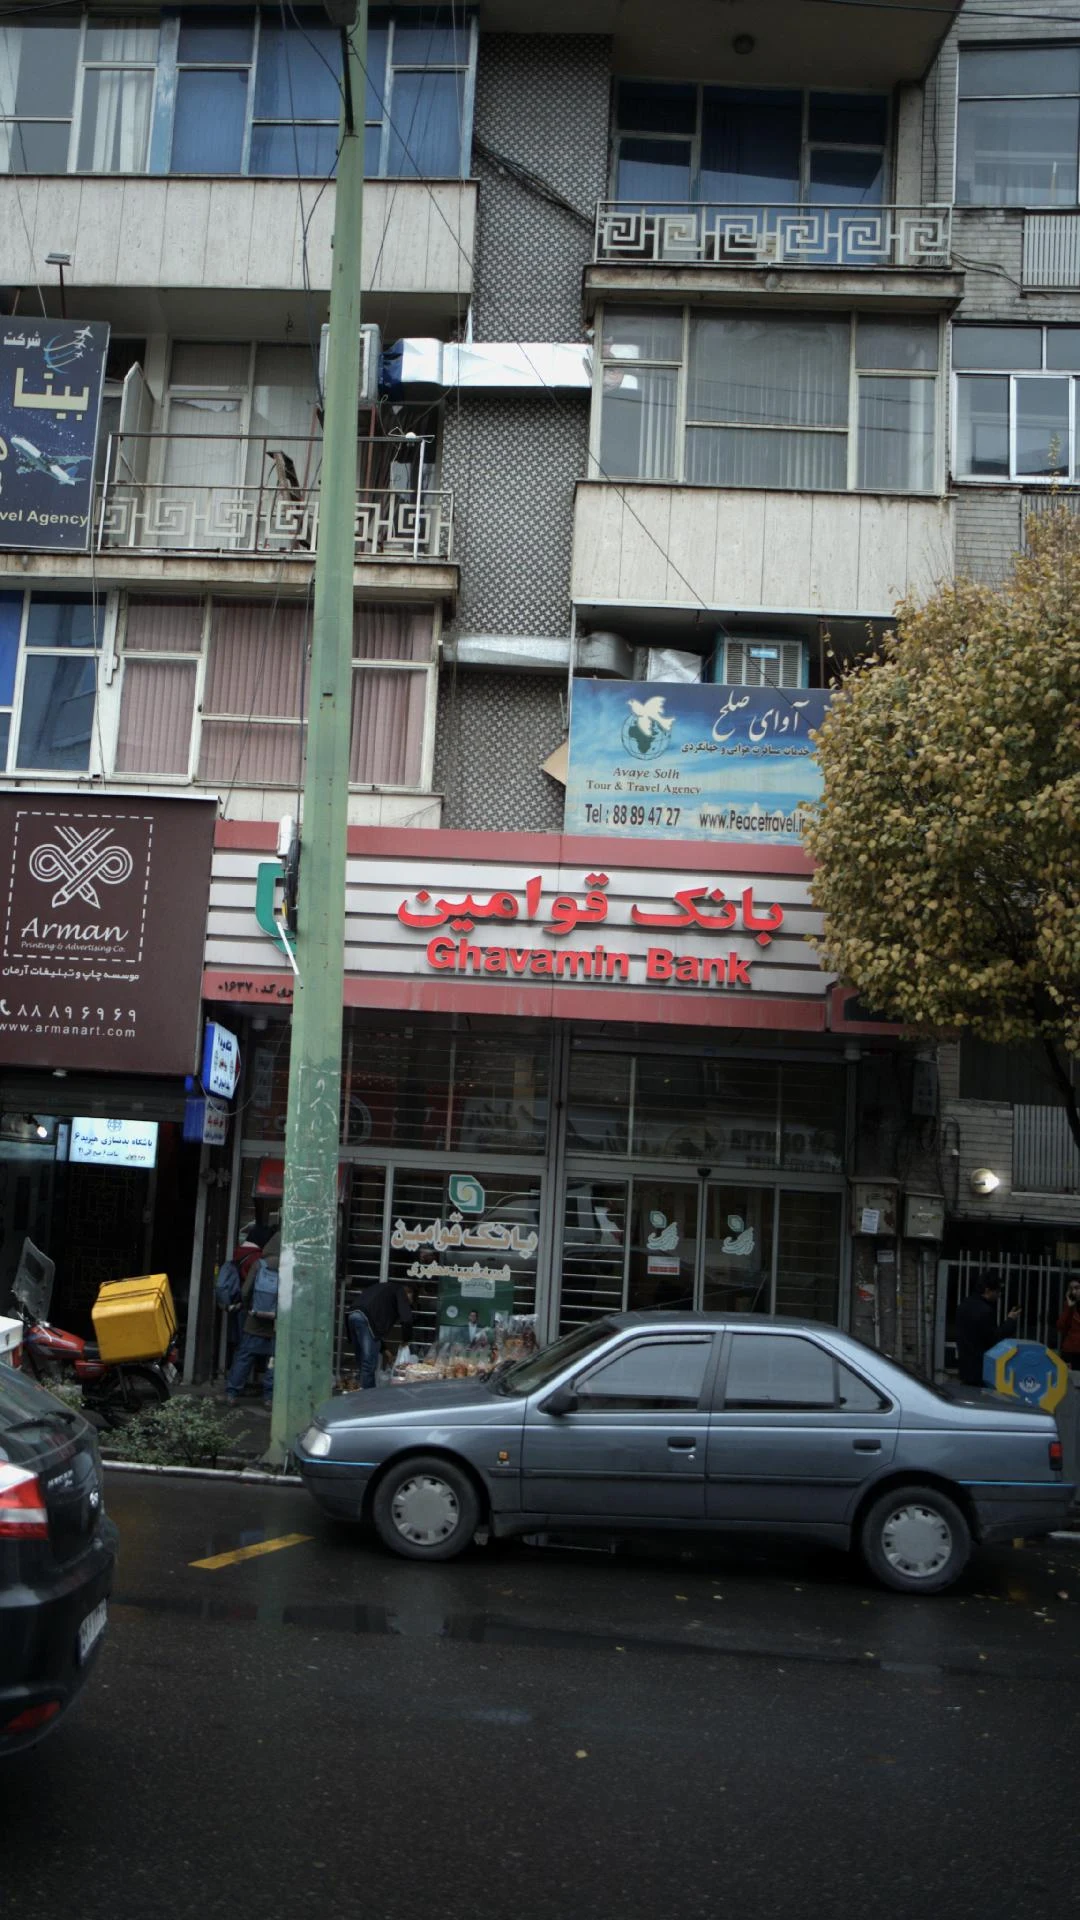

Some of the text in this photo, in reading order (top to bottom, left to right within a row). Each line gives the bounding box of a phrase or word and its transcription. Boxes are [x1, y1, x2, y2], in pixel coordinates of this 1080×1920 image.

[3, 331, 41, 349] شرکت
[26, 510, 88, 527] Agency
[712, 690, 810, 742] آوای صلح
[613, 767, 680, 779] Avaye Solh
[587, 780, 701, 795] Tour & Travel Agency
[397, 872, 783, 947] بانک قوامین
[21, 917, 129, 942] Arman
[21, 941, 55, 952] Printing
[65, 943, 112, 954] Advertising
[113, 945, 126, 953] Co.
[426, 936, 753, 985] Ghavamin Bank
[2, 964, 140, 982] موسسه چاپ و تبلیغات آرمان
[391, 1212, 538, 1259] بانک قوامین
